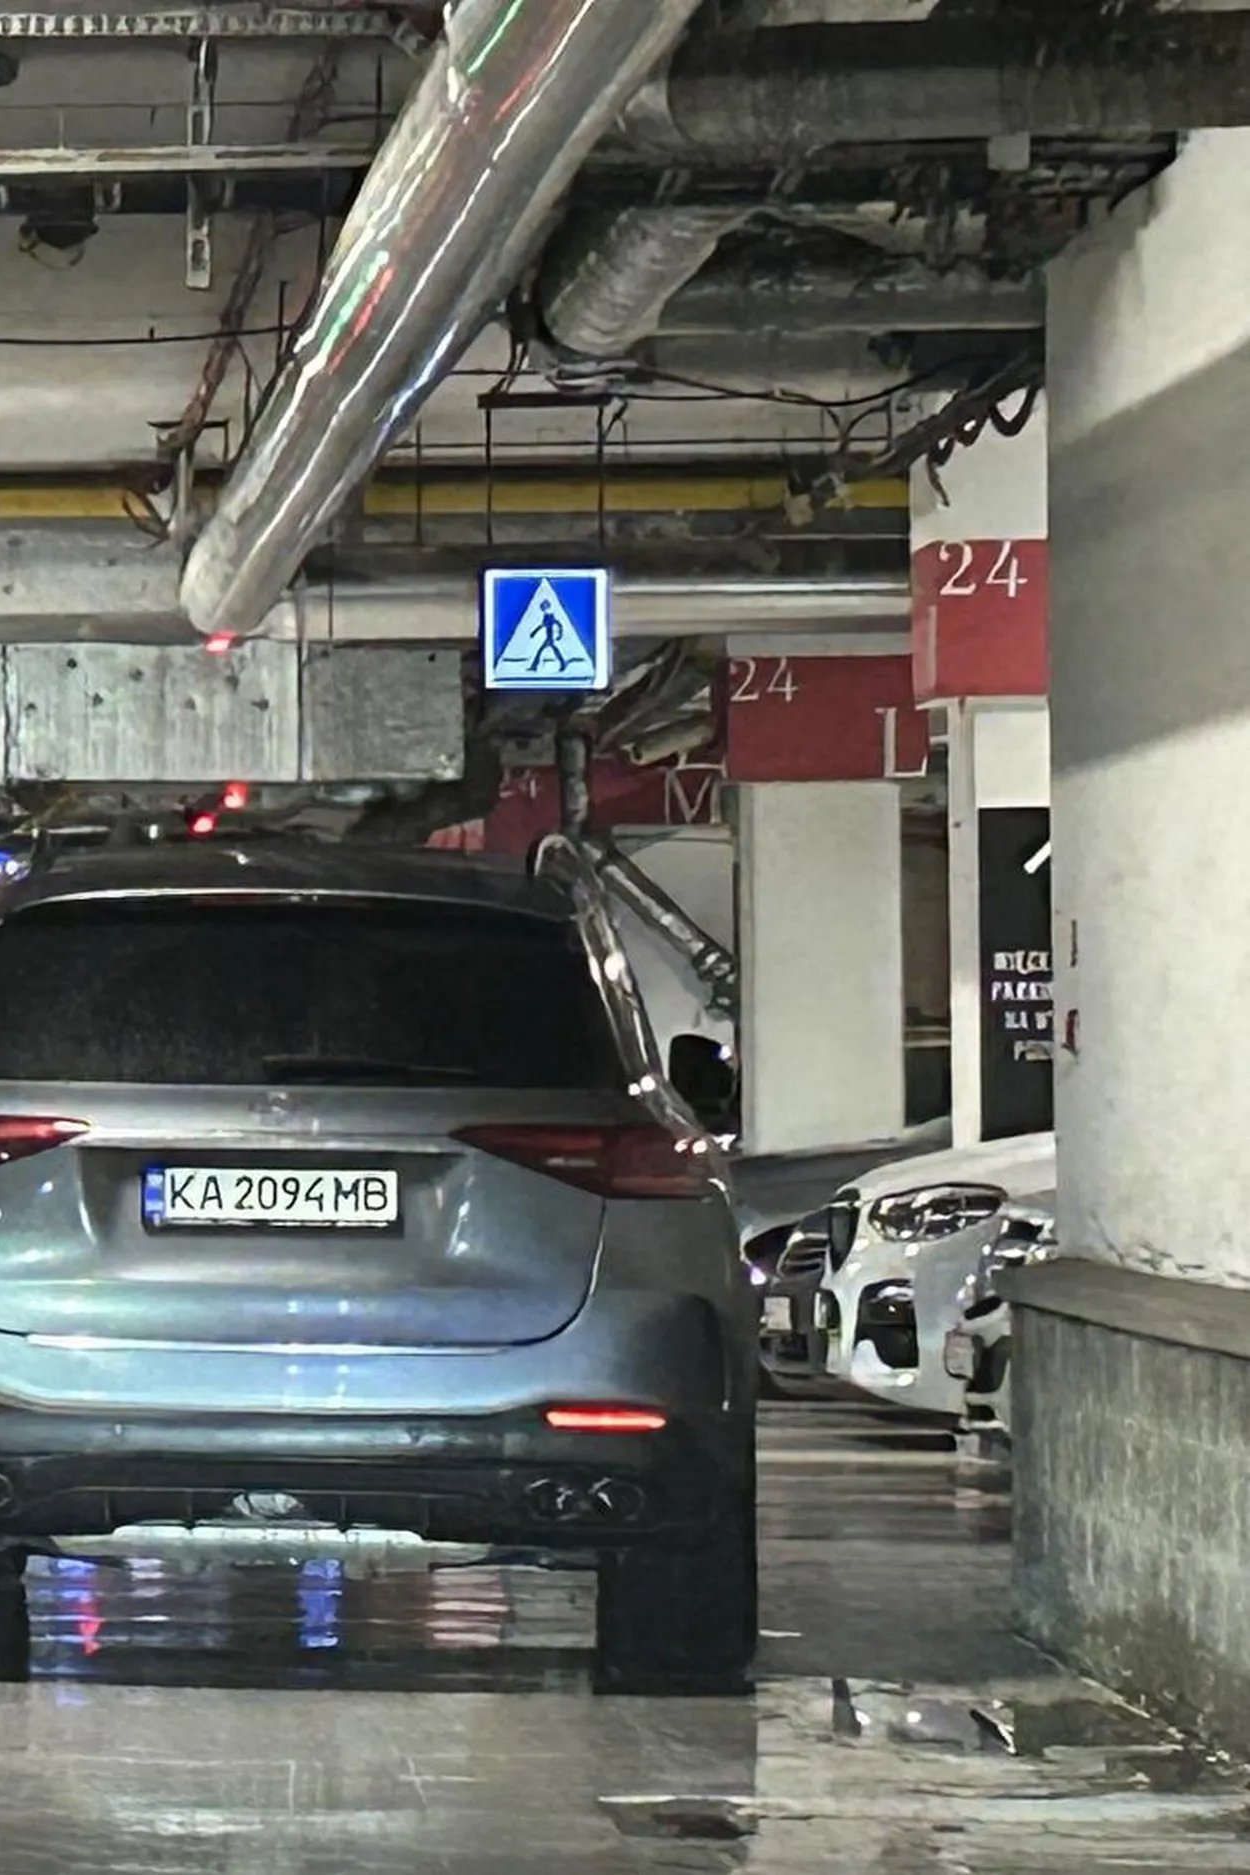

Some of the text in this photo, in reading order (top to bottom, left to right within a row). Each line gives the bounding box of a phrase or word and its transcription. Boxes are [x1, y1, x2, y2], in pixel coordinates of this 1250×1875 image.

[938, 540, 1029, 598] 24
[729, 657, 798, 703] 24
[874, 707, 928, 778] L
[169, 1173, 389, 1212] KA 2094 MB
